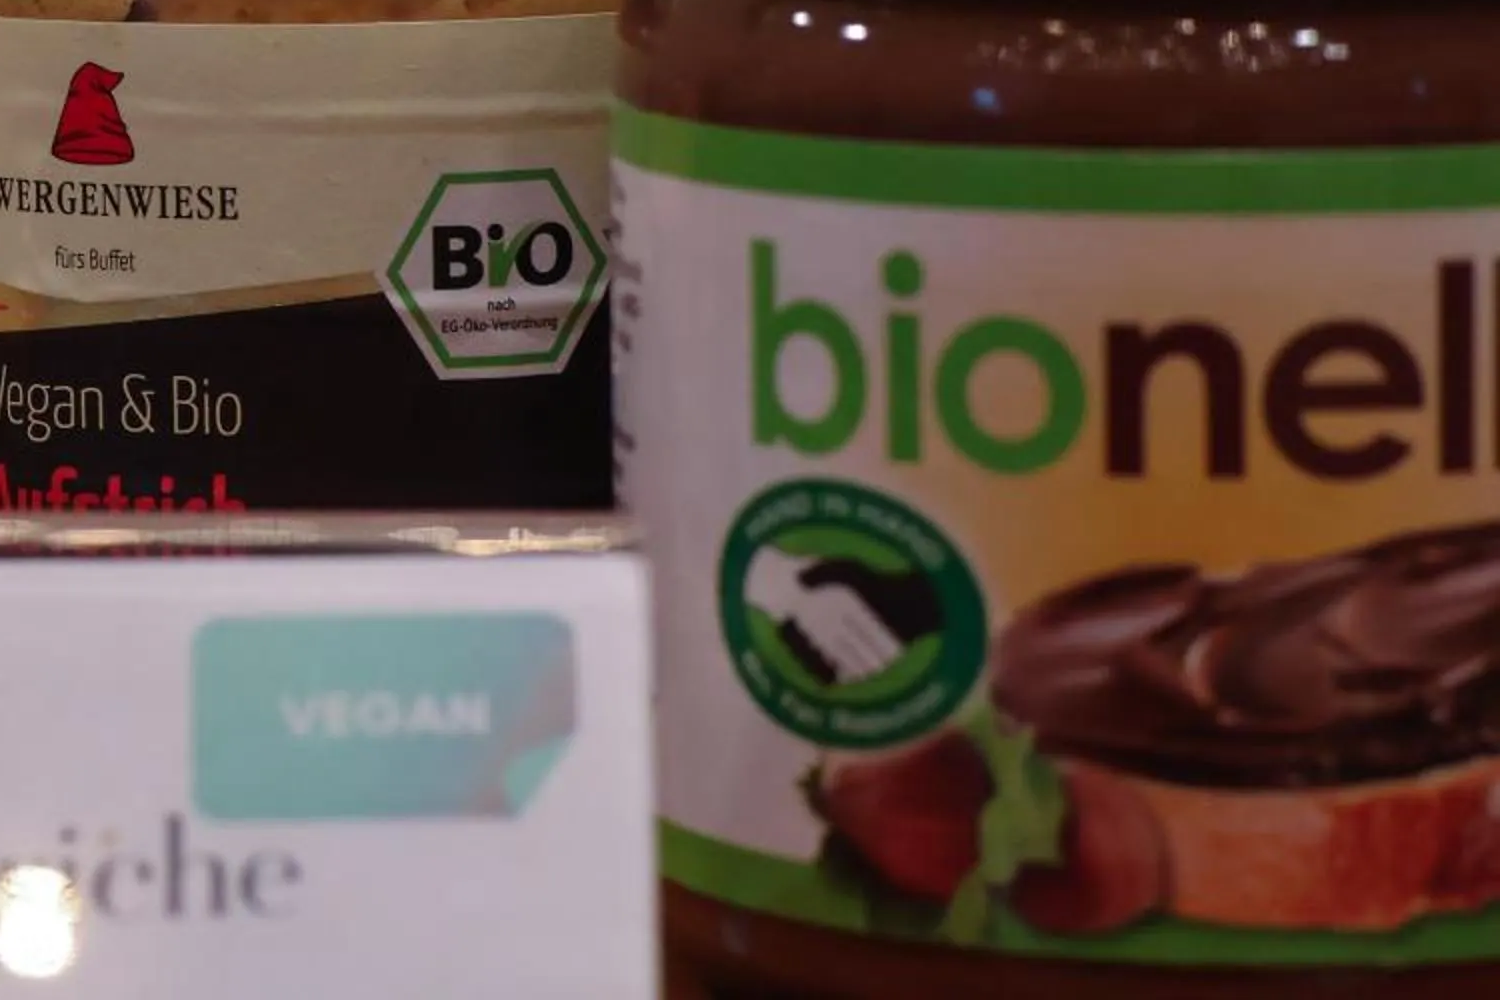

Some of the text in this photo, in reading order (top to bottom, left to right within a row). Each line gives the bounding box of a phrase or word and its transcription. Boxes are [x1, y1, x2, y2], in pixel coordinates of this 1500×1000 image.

[55, 246, 136, 274] fürs Buffet
[487, 297, 516, 312] nach
[441, 316, 558, 334] EG-Öko-Verordnung
[749, 238, 1500, 484] bionel
[120, 373, 156, 434] &
[173, 375, 242, 437] Bio
[279, 692, 490, 738] VEGAN
